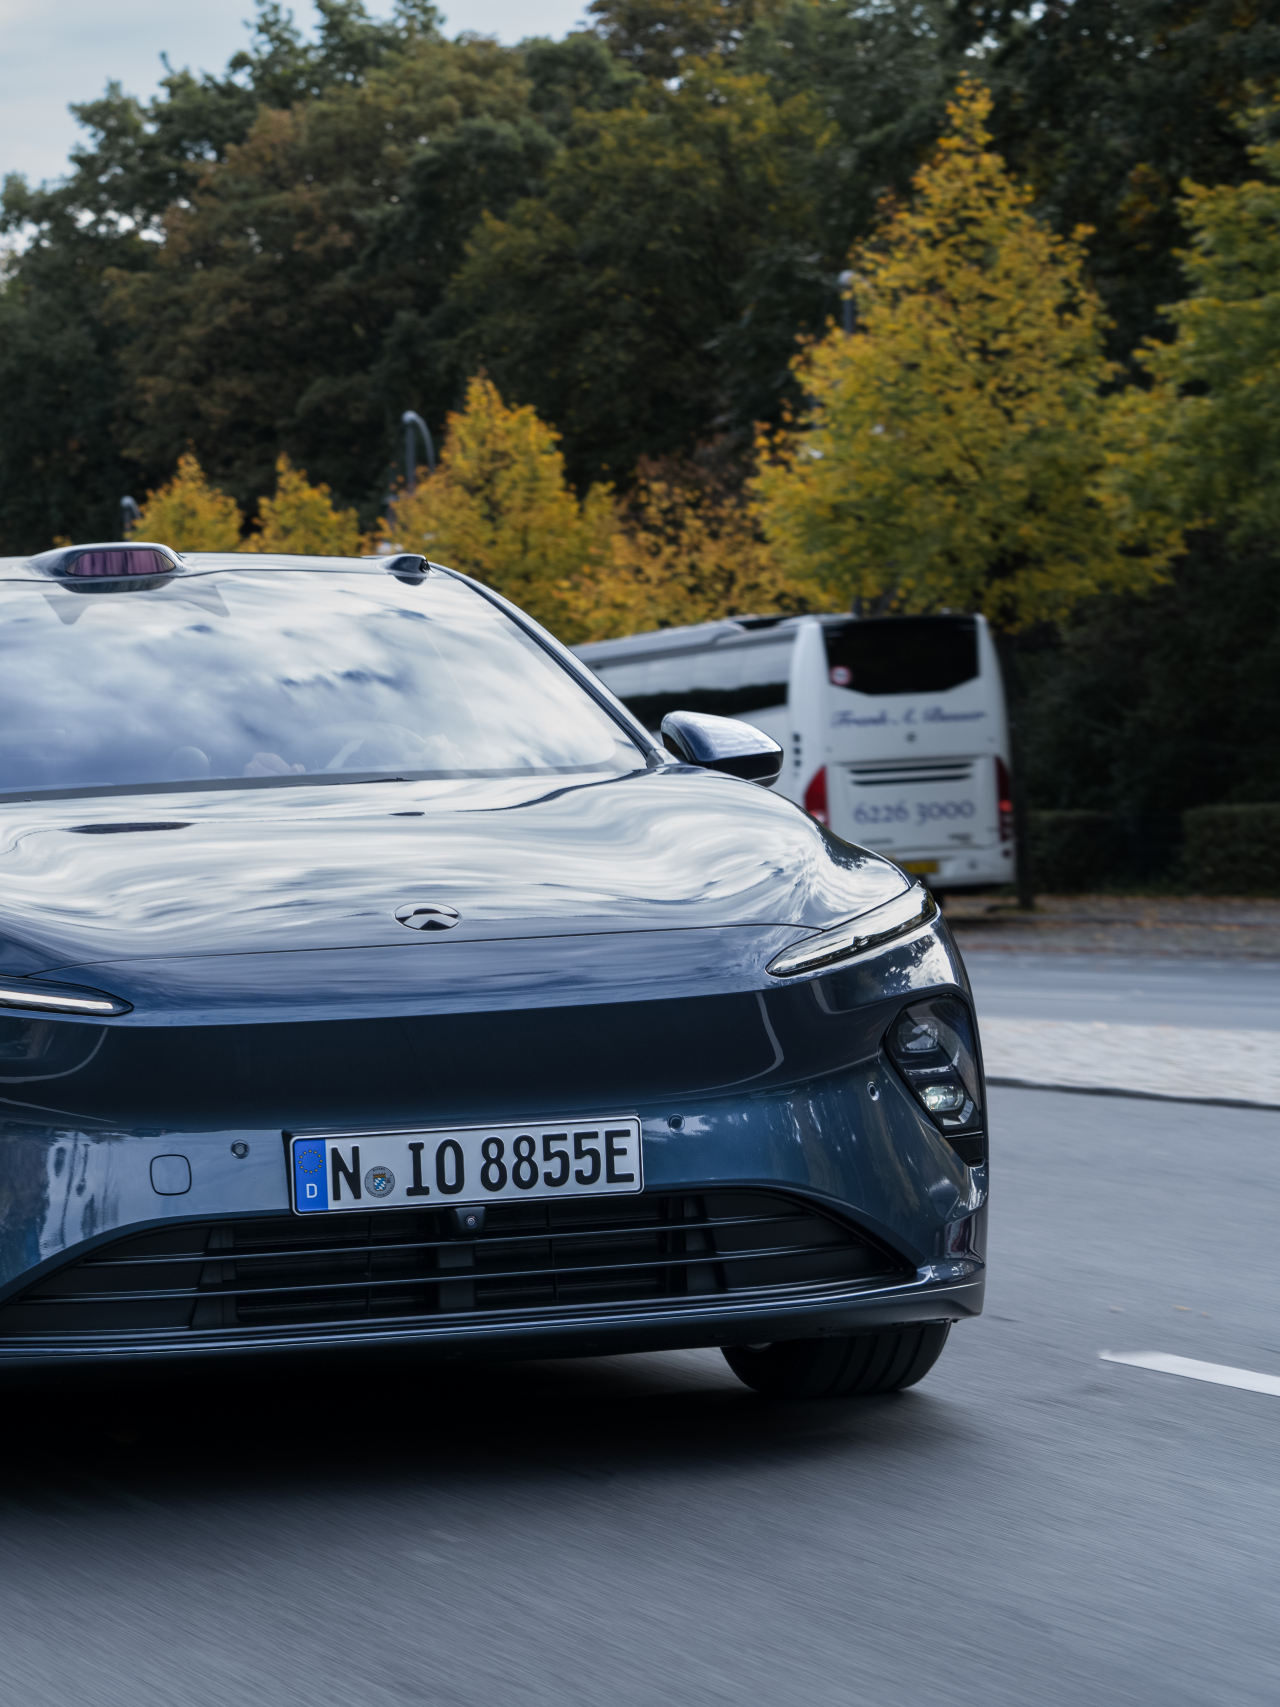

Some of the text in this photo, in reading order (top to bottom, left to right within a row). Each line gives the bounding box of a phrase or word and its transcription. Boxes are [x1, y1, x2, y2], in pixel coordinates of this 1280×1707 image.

[853, 800, 975, 826] 6226 3000
[331, 1145, 361, 1200] N
[480, 1129, 634, 1191] 8855E
[306, 1183, 318, 1198] D
